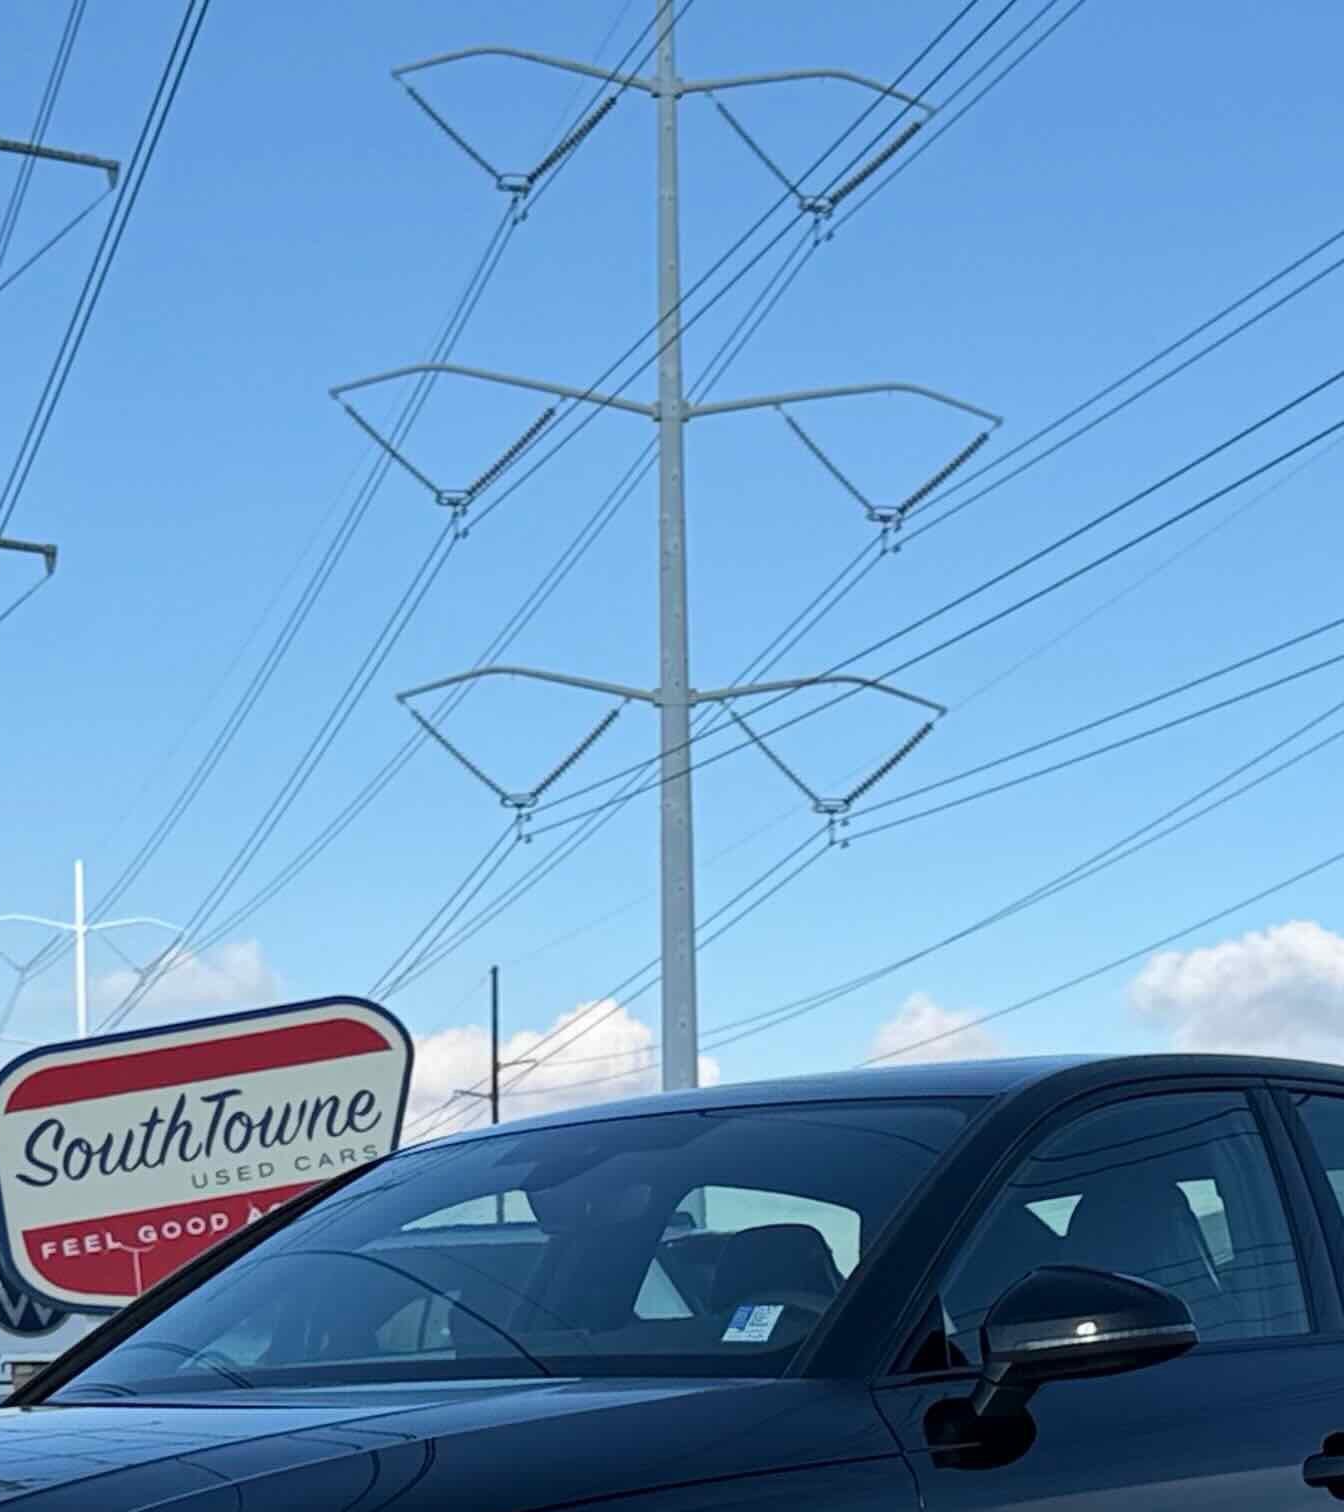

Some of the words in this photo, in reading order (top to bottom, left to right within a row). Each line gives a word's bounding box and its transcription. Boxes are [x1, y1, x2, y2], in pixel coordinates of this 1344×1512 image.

[15, 1088, 382, 1187] SouthTowne
[192, 1161, 275, 1189] USED
[294, 1143, 378, 1172] CARS
[41, 1231, 122, 1260] FEEL
[138, 1212, 229, 1244] GOOD
